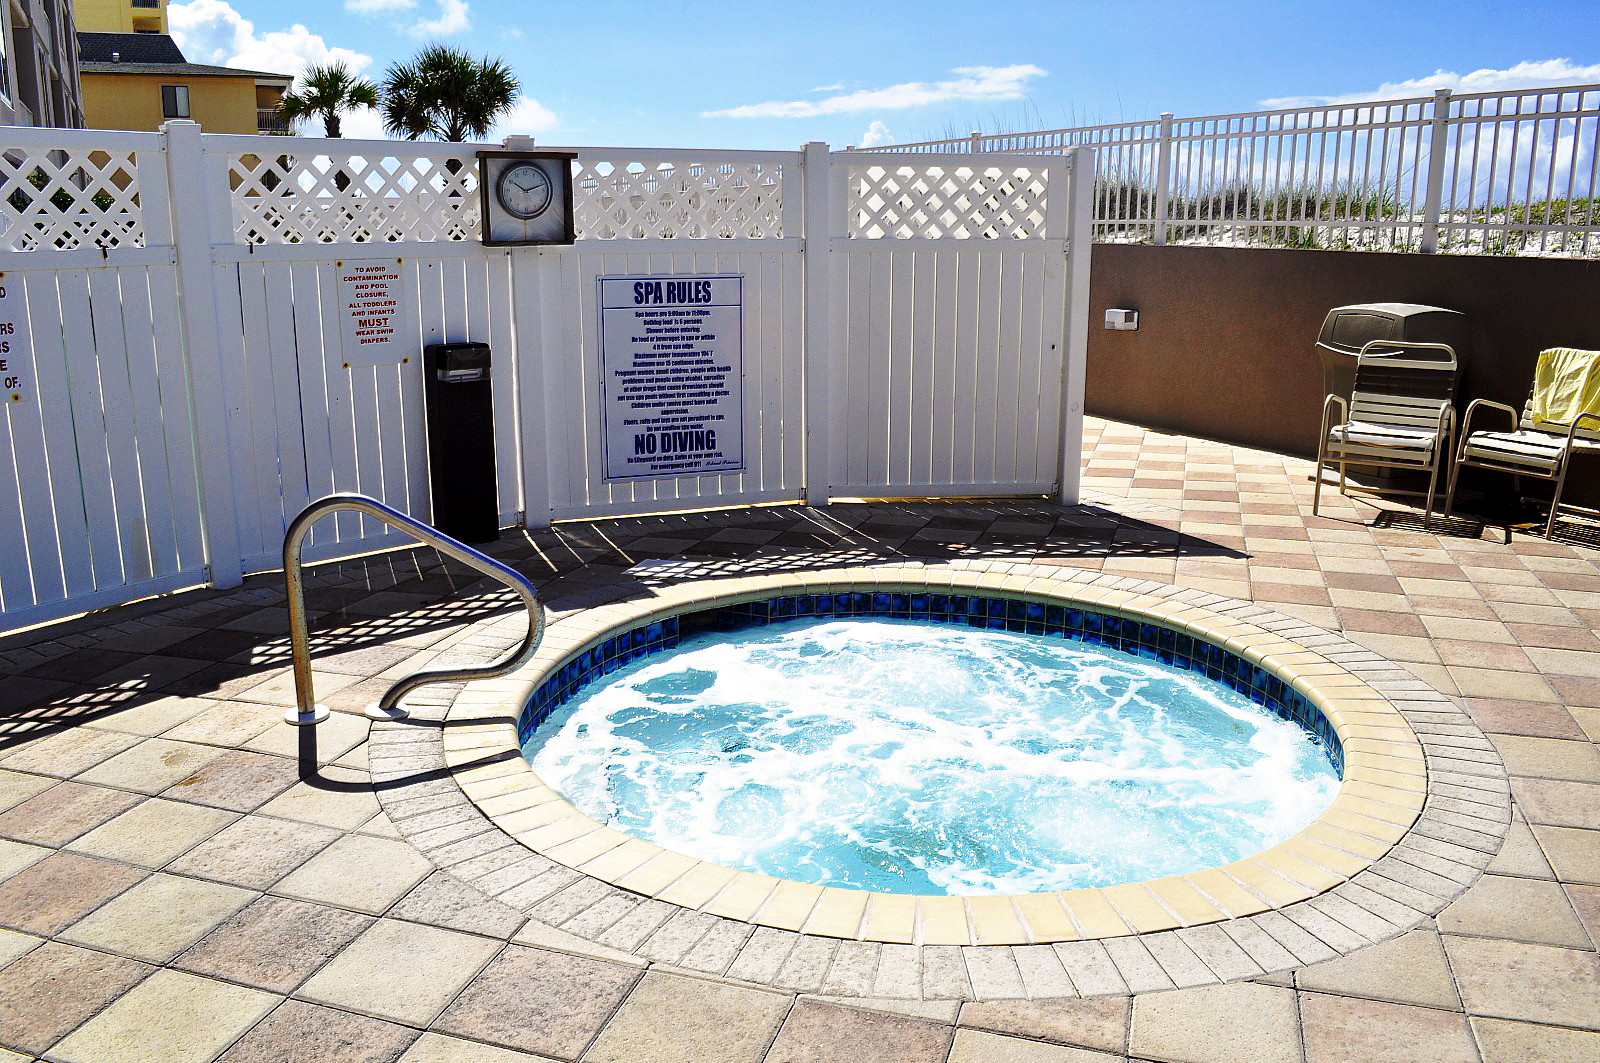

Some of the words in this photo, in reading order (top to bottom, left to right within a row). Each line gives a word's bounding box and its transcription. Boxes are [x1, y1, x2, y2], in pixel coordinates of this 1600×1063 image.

[344, 274, 398, 282] CONTAMINATION
[634, 282, 663, 304] SPA
[667, 281, 711, 304] RULES
[359, 318, 389, 327] MUST
[5, 377, 21, 389] OF.
[634, 433, 656, 455] NO
[661, 430, 716, 453] DIVING
[659, 462, 684, 470] emergency
